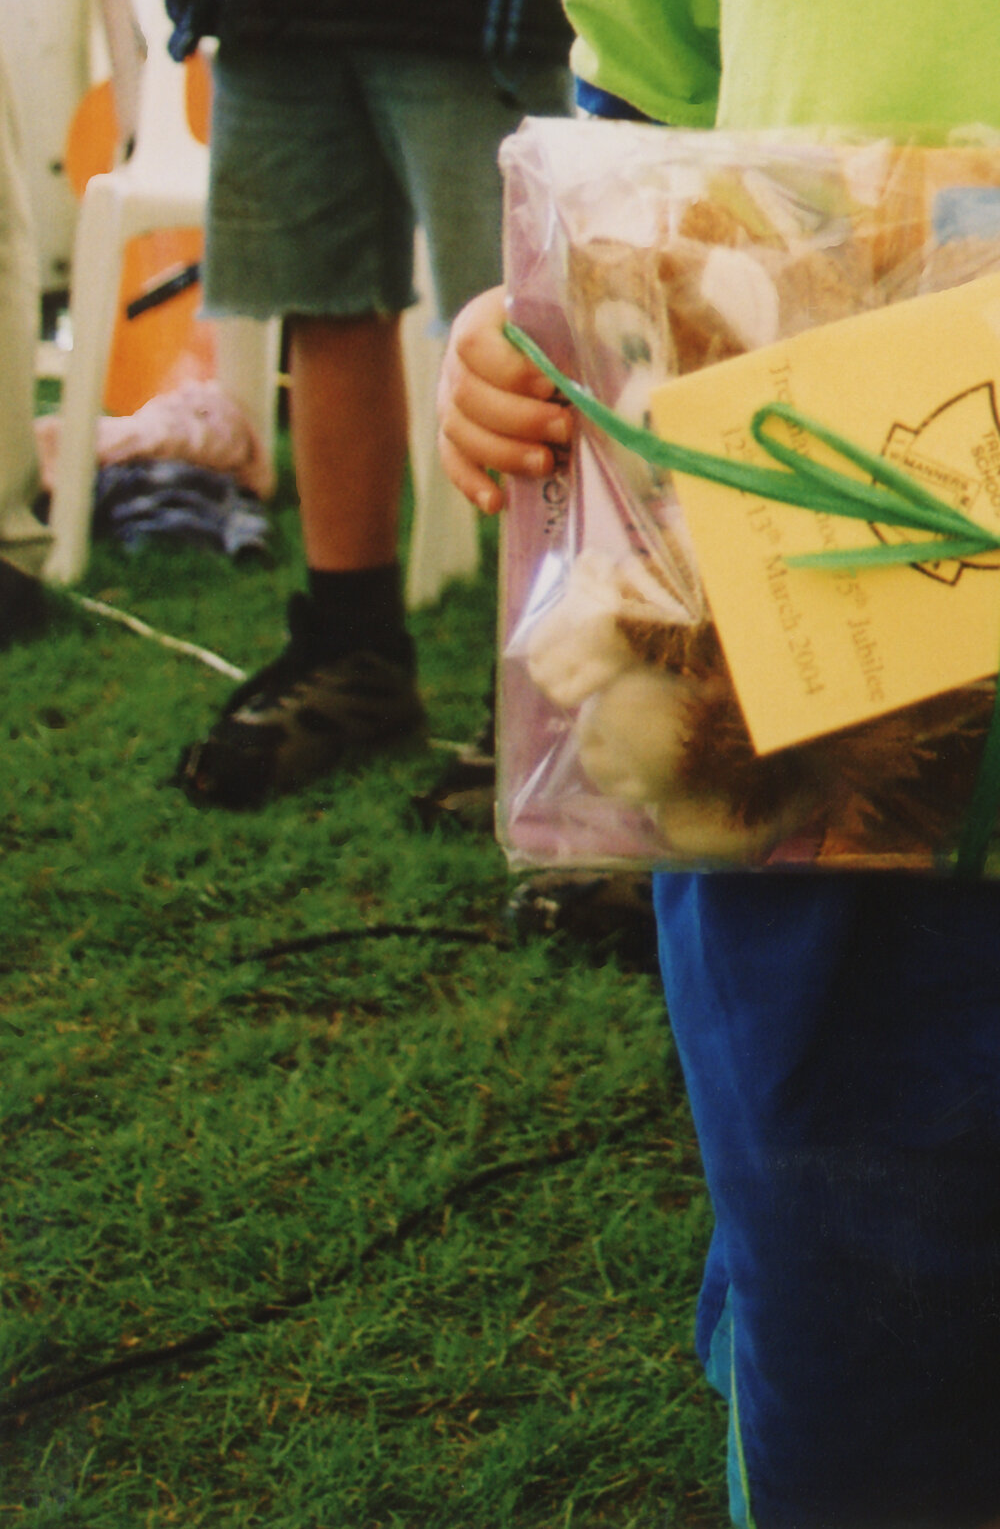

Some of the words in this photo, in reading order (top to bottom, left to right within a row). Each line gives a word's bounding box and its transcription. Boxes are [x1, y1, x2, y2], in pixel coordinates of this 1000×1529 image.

[765, 553, 802, 631] March
[788, 636, 824, 695] 2004
[847, 618, 885, 702] Jubilee
